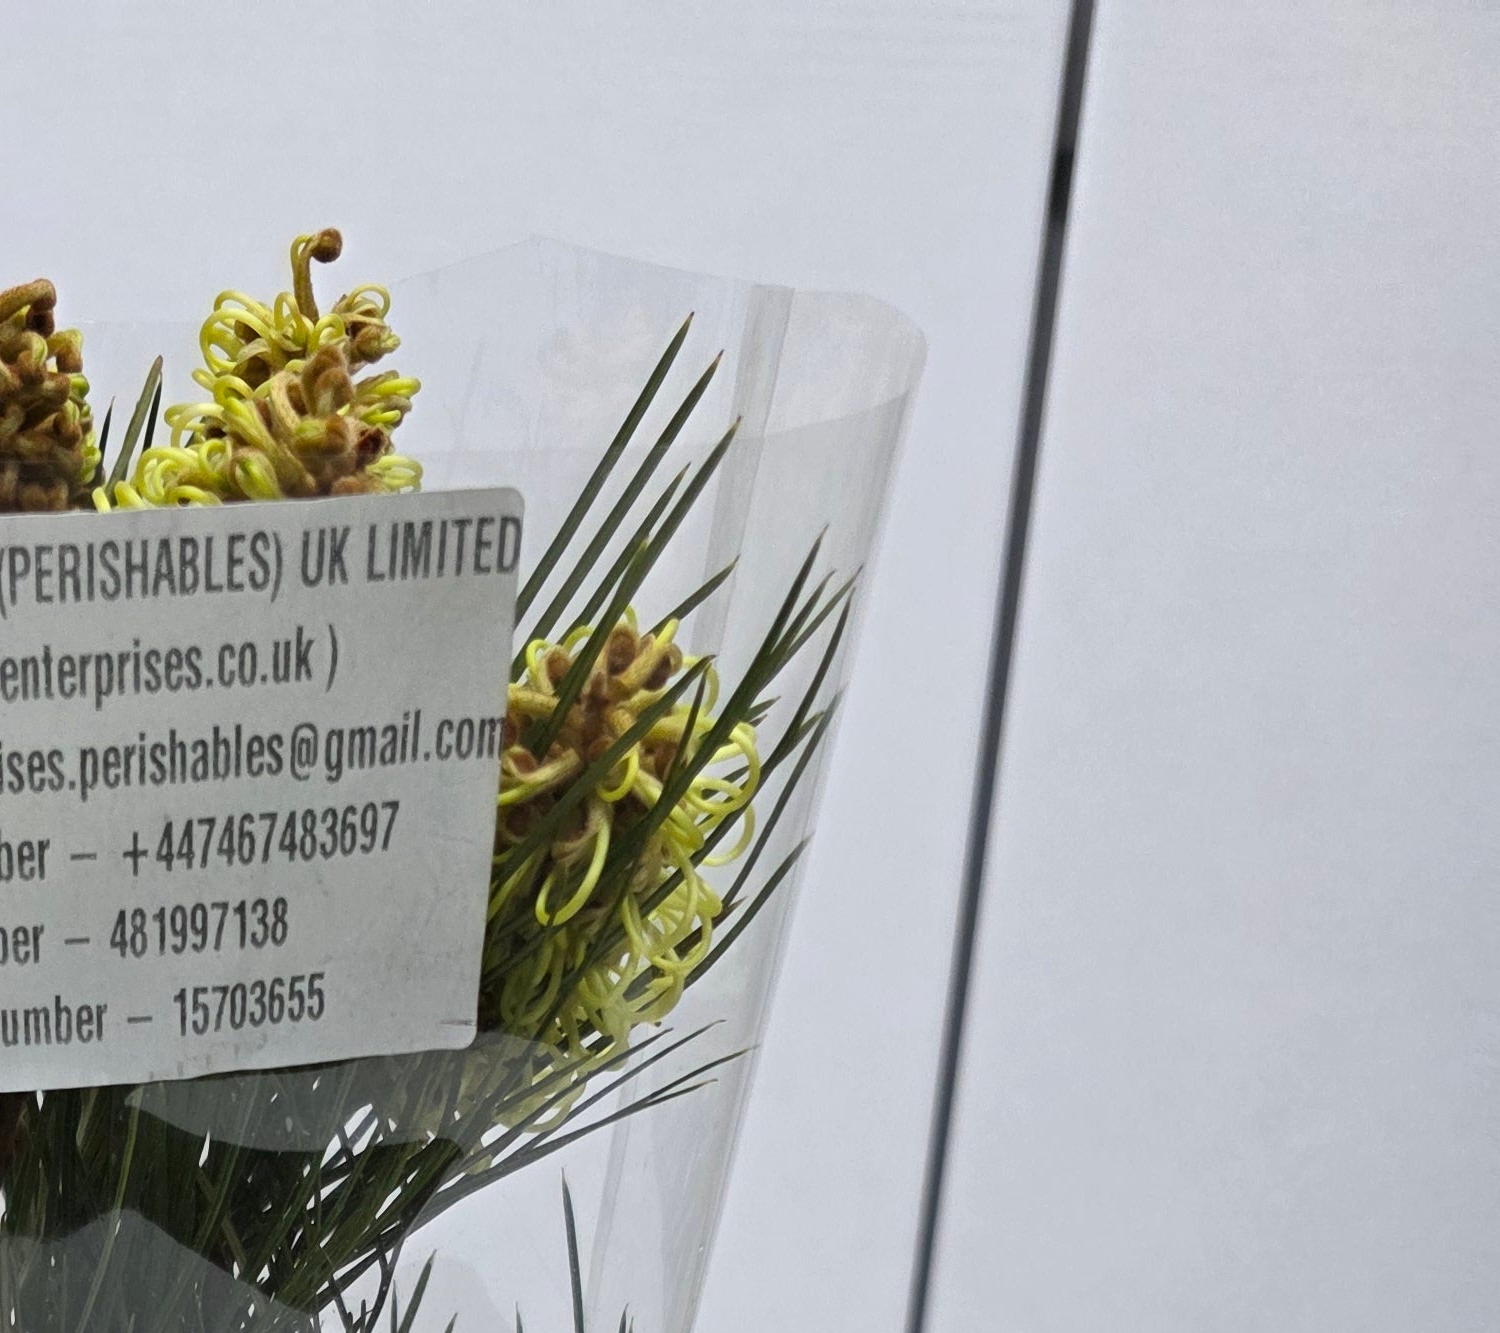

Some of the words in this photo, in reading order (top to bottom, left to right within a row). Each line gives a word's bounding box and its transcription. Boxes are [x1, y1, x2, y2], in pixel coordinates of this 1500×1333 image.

[301, 526, 350, 587] UK
[367, 515, 521, 581] LIMITED
[326, 624, 338, 692] )
[123, 801, 399, 876] +447467483697
[110, 897, 288, 957] 481997138
[174, 972, 324, 1036] 15703655
